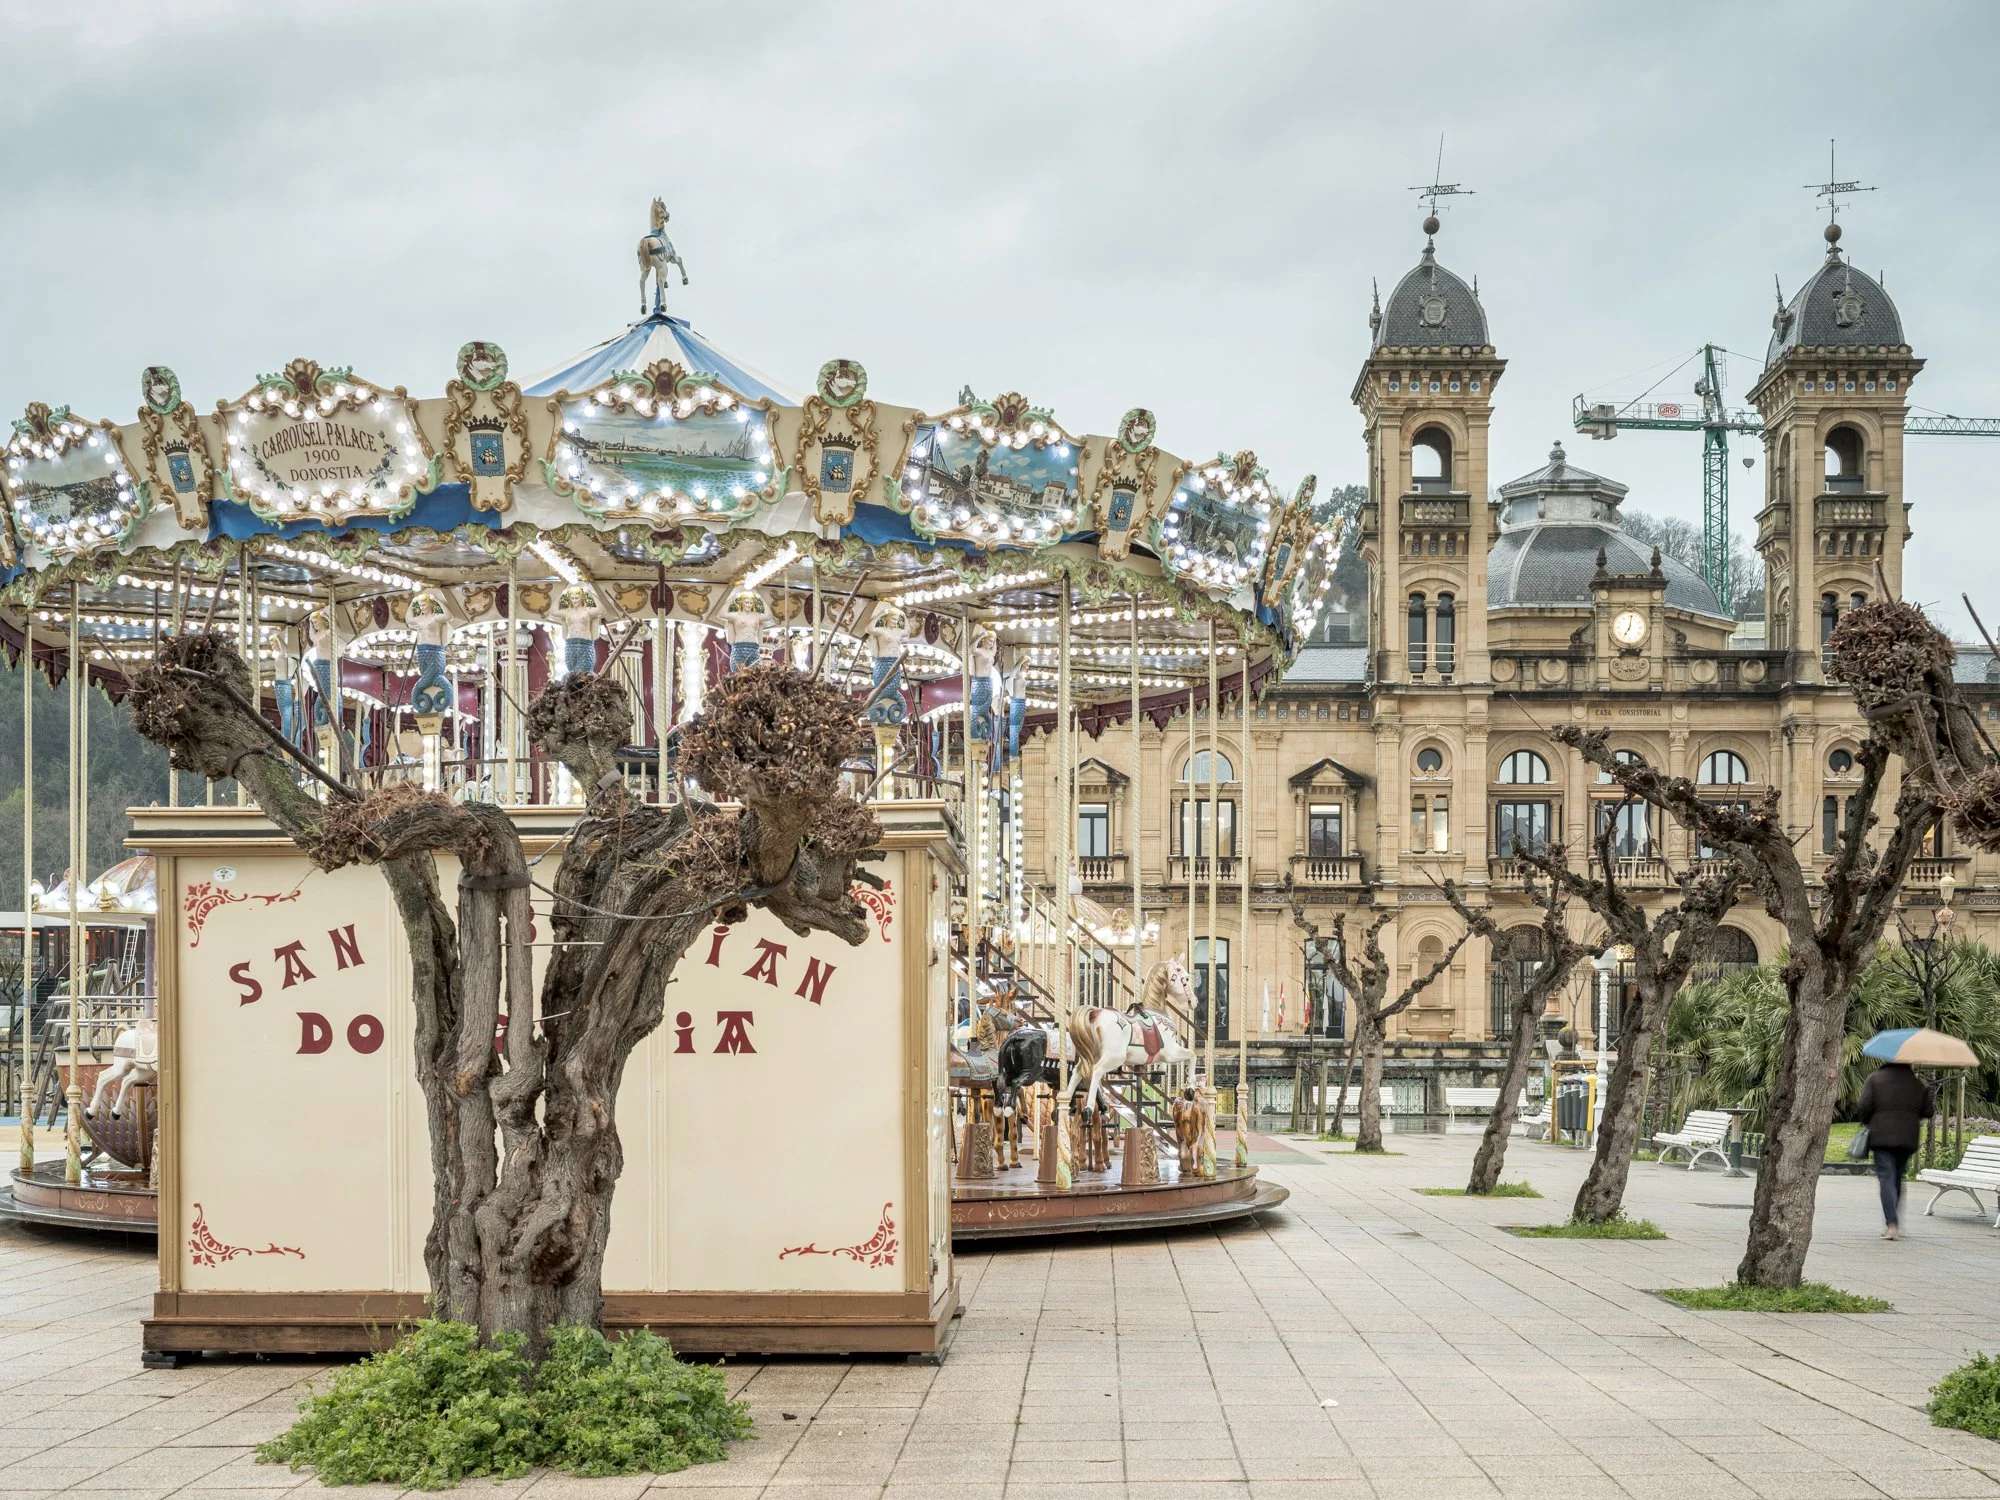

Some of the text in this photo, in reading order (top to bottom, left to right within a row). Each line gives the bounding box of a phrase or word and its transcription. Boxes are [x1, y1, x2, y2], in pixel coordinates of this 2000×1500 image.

[262, 421, 378, 460] CARROUSEL PALACE
[304, 449, 341, 464] 1900
[290, 465, 364, 482] DONOSTIA
[1595, 708, 1662, 717] CASA CONSISTORIAL
[228, 923, 366, 1006] SAN
